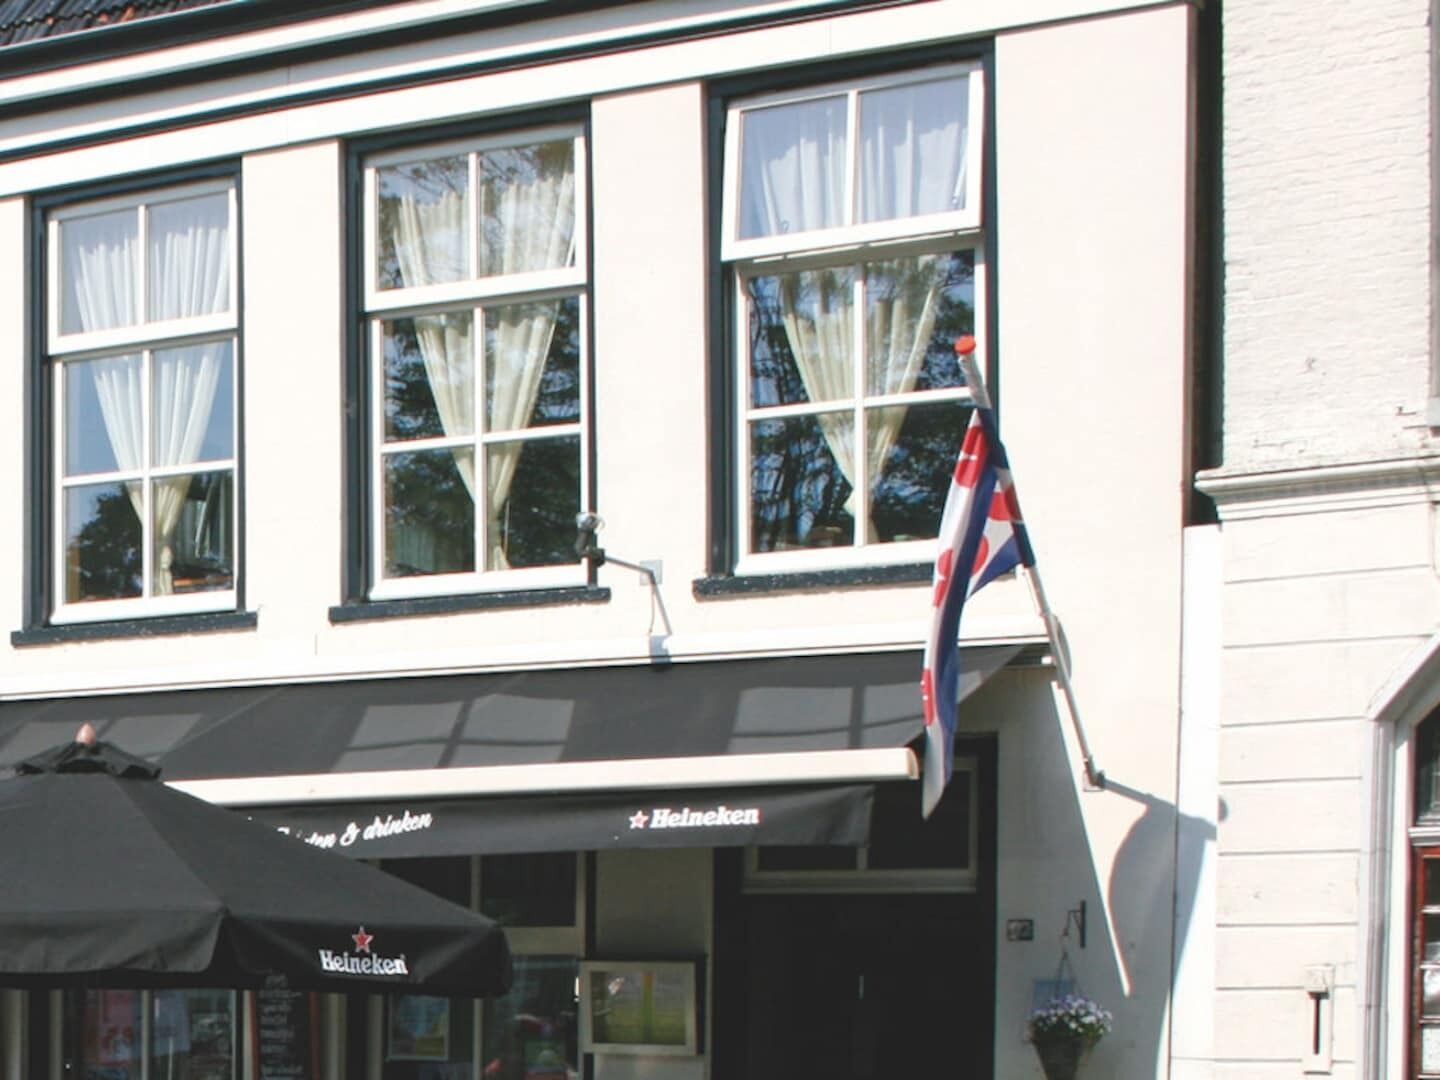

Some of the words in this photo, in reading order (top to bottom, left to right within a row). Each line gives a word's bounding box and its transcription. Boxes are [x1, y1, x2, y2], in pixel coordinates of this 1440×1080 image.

[362, 809, 433, 840] drinken
[649, 806, 760, 829] Heineken
[319, 949, 409, 976] Heineken
